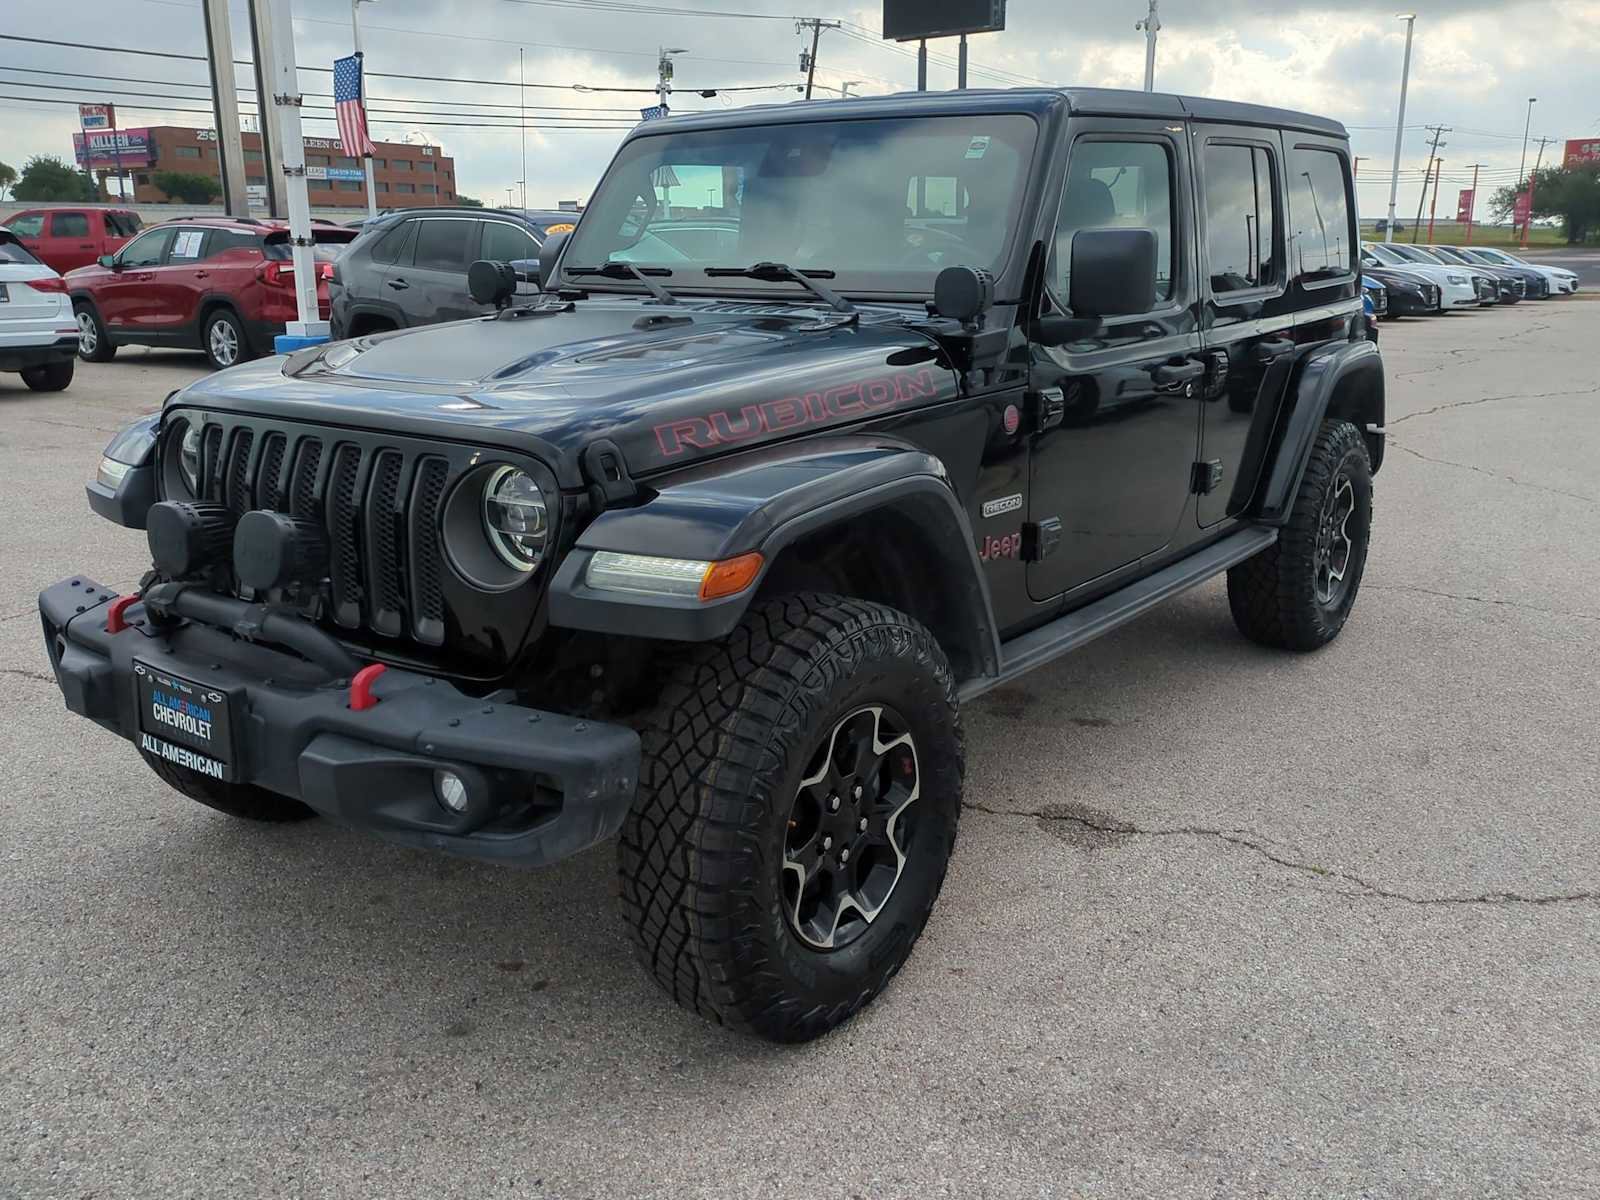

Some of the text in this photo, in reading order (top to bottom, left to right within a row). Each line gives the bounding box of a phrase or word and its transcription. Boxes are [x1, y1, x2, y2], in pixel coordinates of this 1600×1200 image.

[303, 138, 330, 149] LEEN
[654, 369, 937, 456] RUBICON
[985, 497, 1021, 514] RECON
[979, 532, 1021, 561] Jeep
[153, 689, 211, 722] ALL AMERICAN
[153, 703, 212, 740] CHEVROLET
[142, 733, 223, 780] ALL AMERICAN
